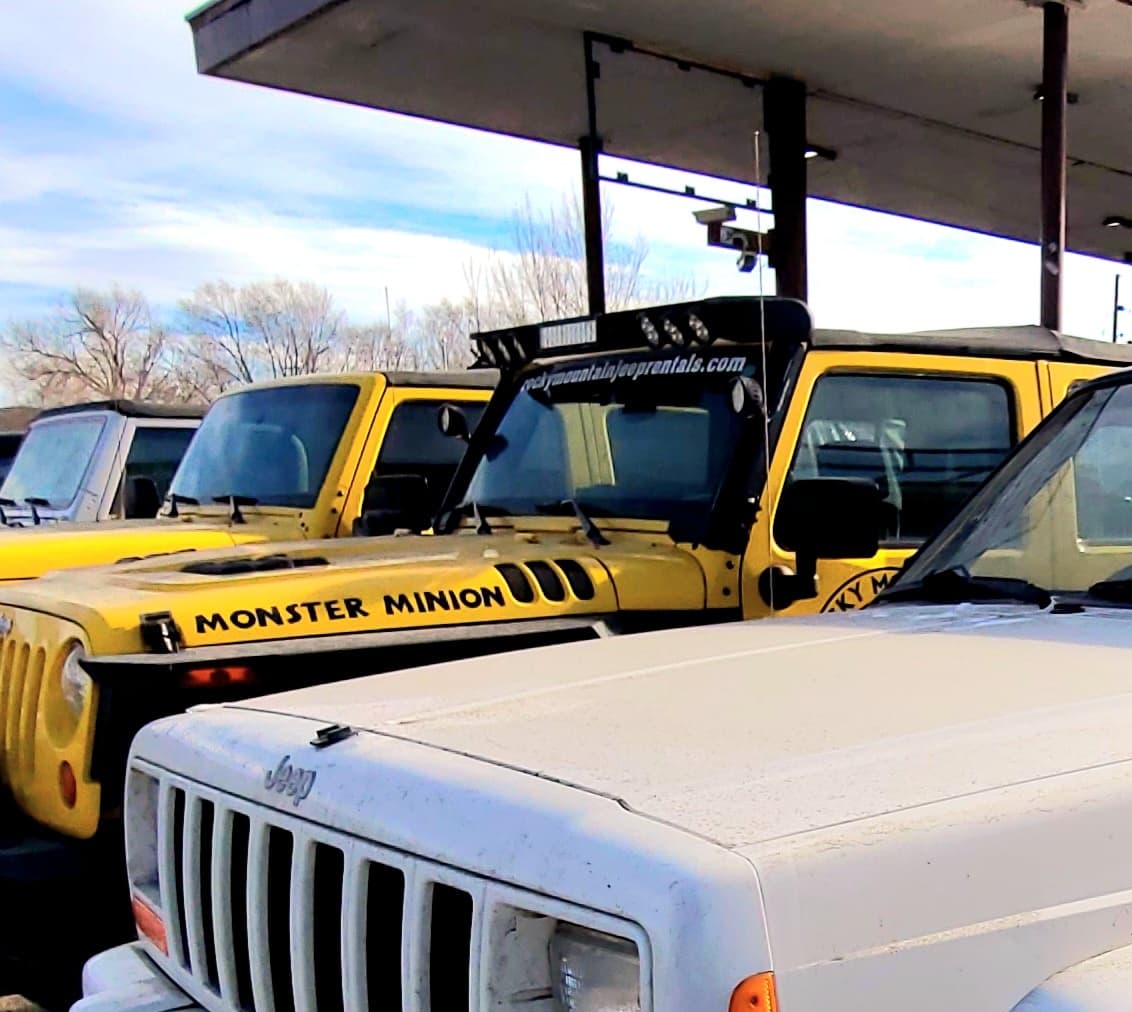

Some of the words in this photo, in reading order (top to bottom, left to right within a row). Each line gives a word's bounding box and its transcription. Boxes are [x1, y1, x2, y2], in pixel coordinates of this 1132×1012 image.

[520, 353, 746, 391] rockymountainjeeprentals.com
[195, 598, 370, 634] MONSTER
[384, 586, 505, 615] MINION
[829, 581, 863, 612] KY
[264, 755, 317, 807] Jeep
